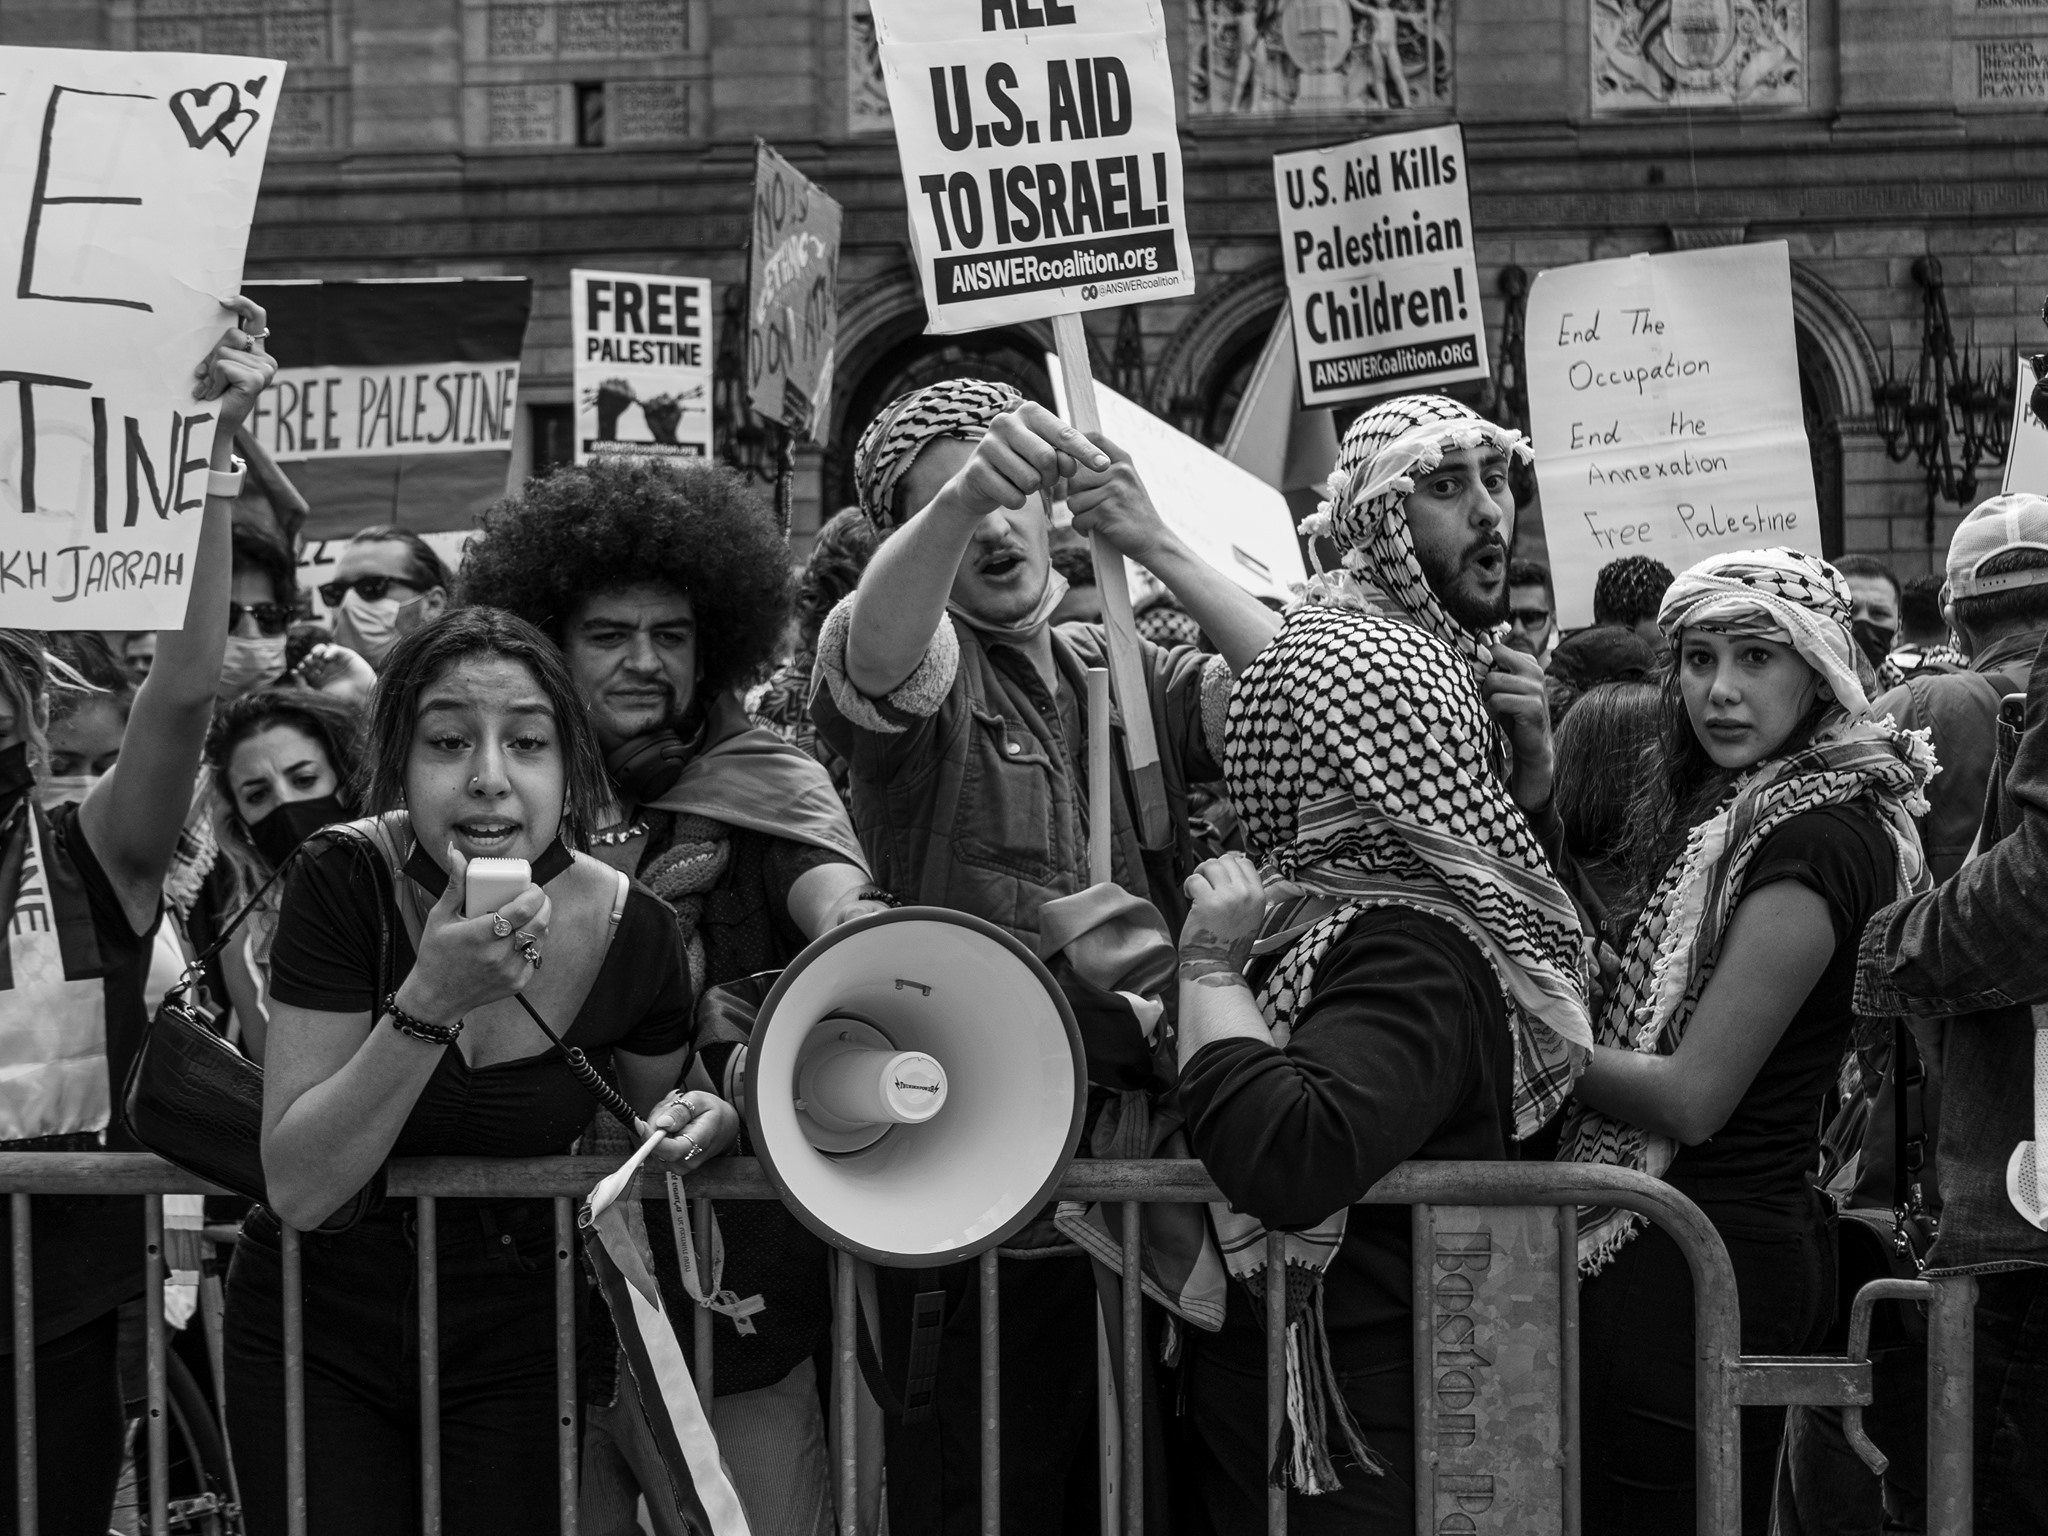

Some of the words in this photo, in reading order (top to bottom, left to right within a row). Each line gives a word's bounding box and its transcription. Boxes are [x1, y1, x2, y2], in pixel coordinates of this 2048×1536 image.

[929, 61, 1041, 151] U.S.
[1047, 56, 1133, 142] AID
[919, 171, 983, 251] TO
[989, 152, 1170, 245] ISRAEL!
[1286, 165, 1337, 210] U.S.
[1344, 154, 1382, 202] Aid
[1390, 145, 1457, 192] Kills
[952, 247, 1158, 294] ANSWERcoalition.org
[1294, 210, 1463, 274] Palestinian
[587, 279, 700, 337] FREE
[1100, 276, 1179, 297] @ANSWERcoalition
[1305, 267, 1467, 345] Children!
[587, 338, 701, 367] PALESTINE
[1558, 310, 1600, 346] End
[1620, 308, 1665, 335] The
[1569, 352, 1710, 396] Occupation
[252, 378, 342, 452] FREE
[356, 368, 515, 449] PALESTINE
[1571, 420, 1621, 449] End
[1669, 411, 1706, 436] the
[0, 371, 214, 533] TINE
[1589, 449, 1728, 485] Annexation
[1584, 511, 1651, 550] Free
[1676, 503, 1798, 541] Palestine
[0, 551, 47, 594] KH
[52, 546, 184, 603] JARRAH
[1435, 1232, 1492, 1449] Boston
